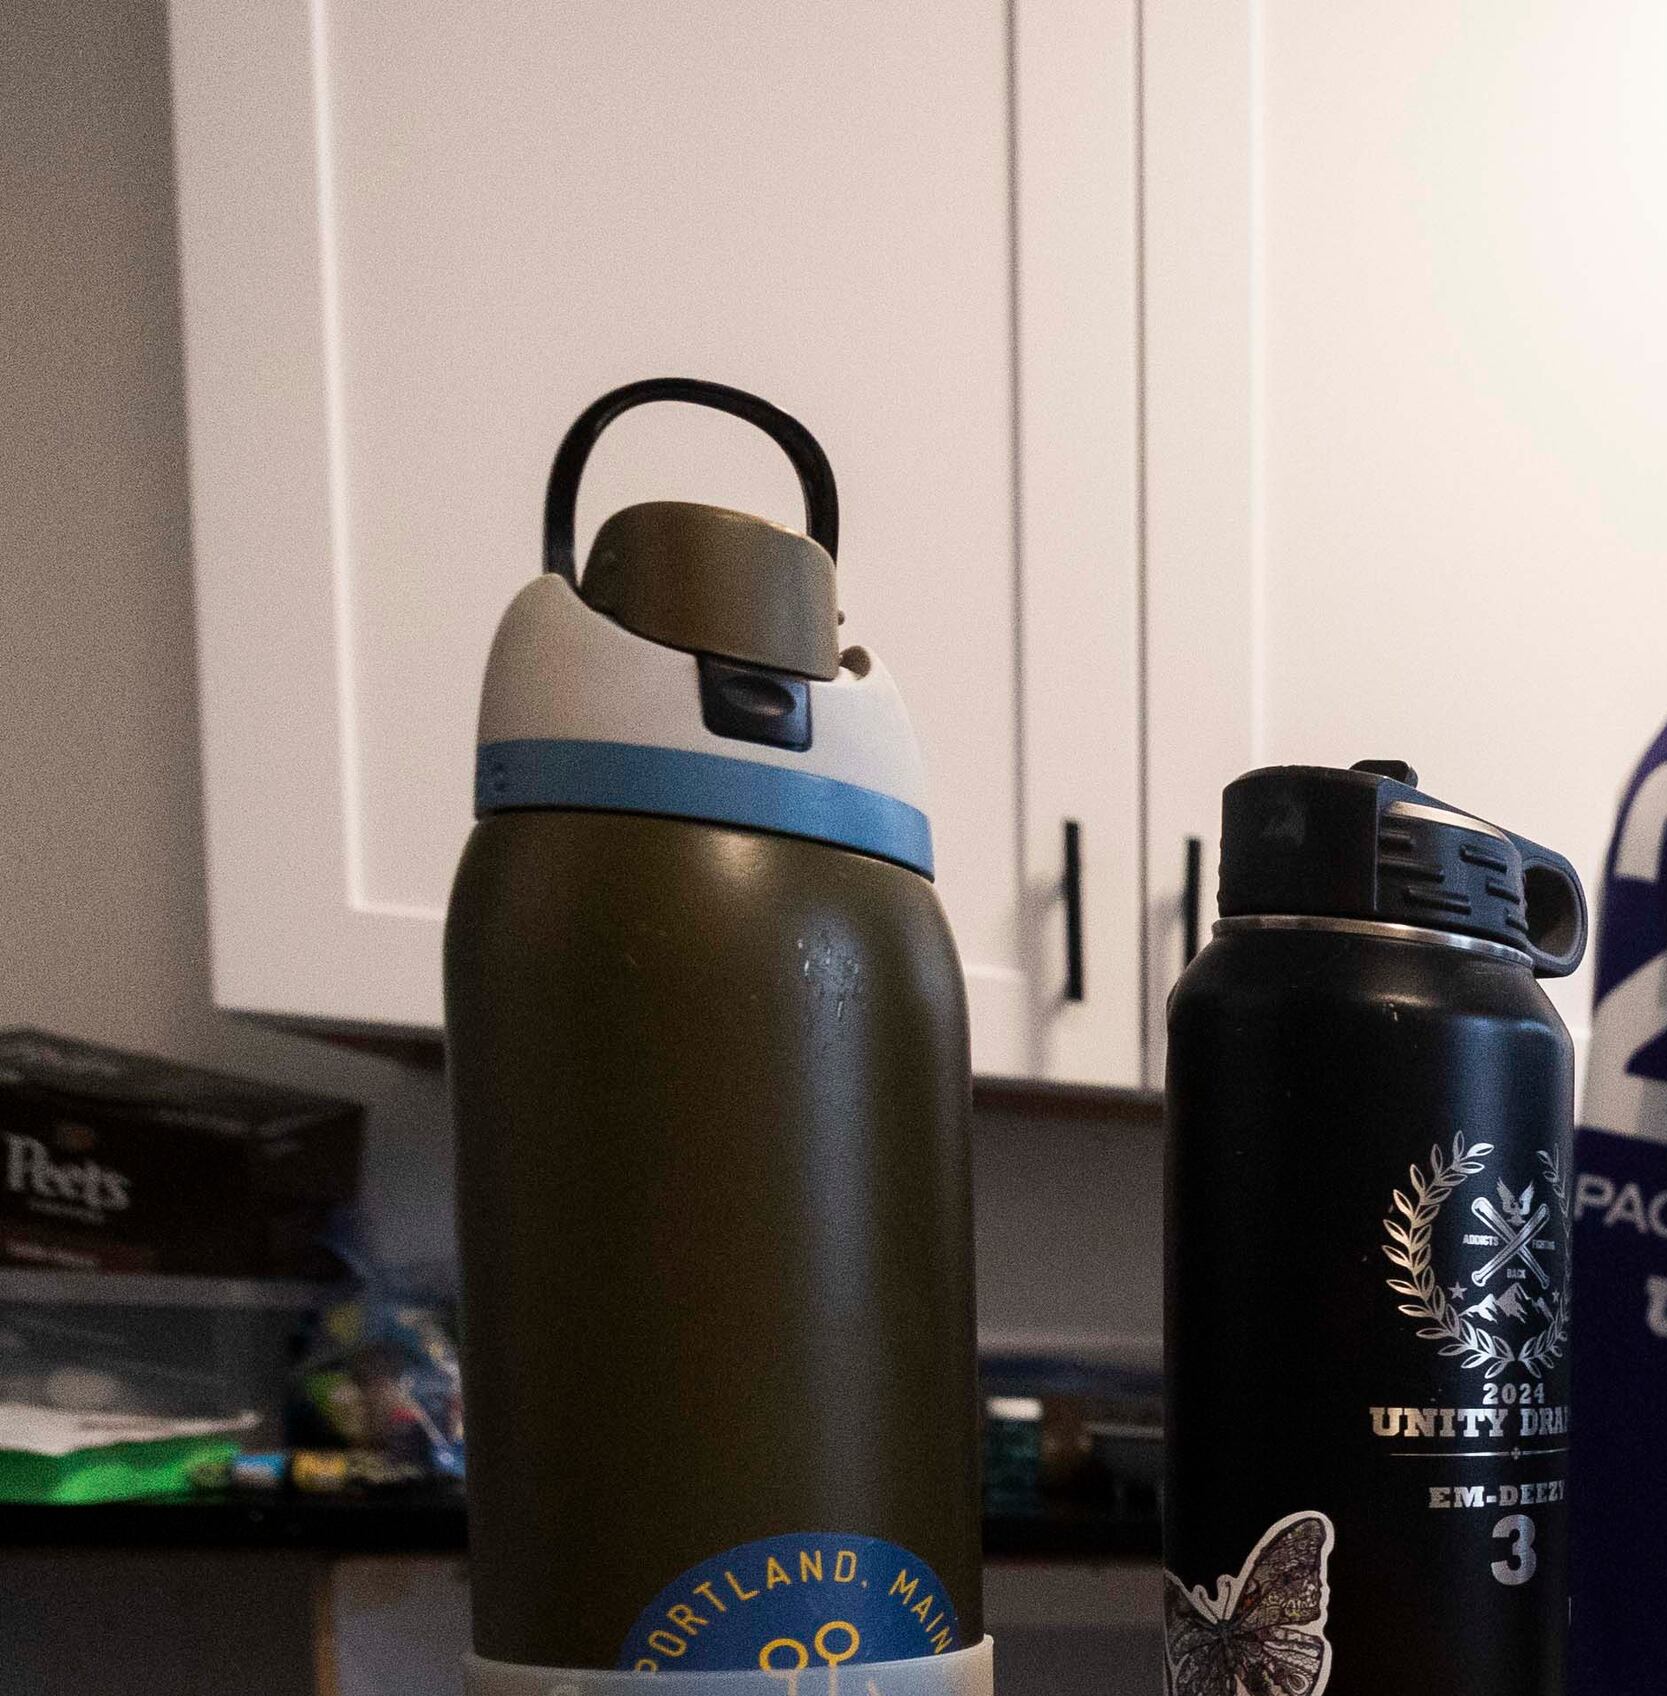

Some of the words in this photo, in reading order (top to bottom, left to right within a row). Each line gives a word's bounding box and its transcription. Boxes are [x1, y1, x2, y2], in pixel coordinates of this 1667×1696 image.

[1462, 1234, 1499, 1246] ADDICTS
[1482, 1383, 1545, 1405] 2024
[1369, 1407, 1508, 1437] UNITY
[1490, 1514, 1538, 1586] 3
